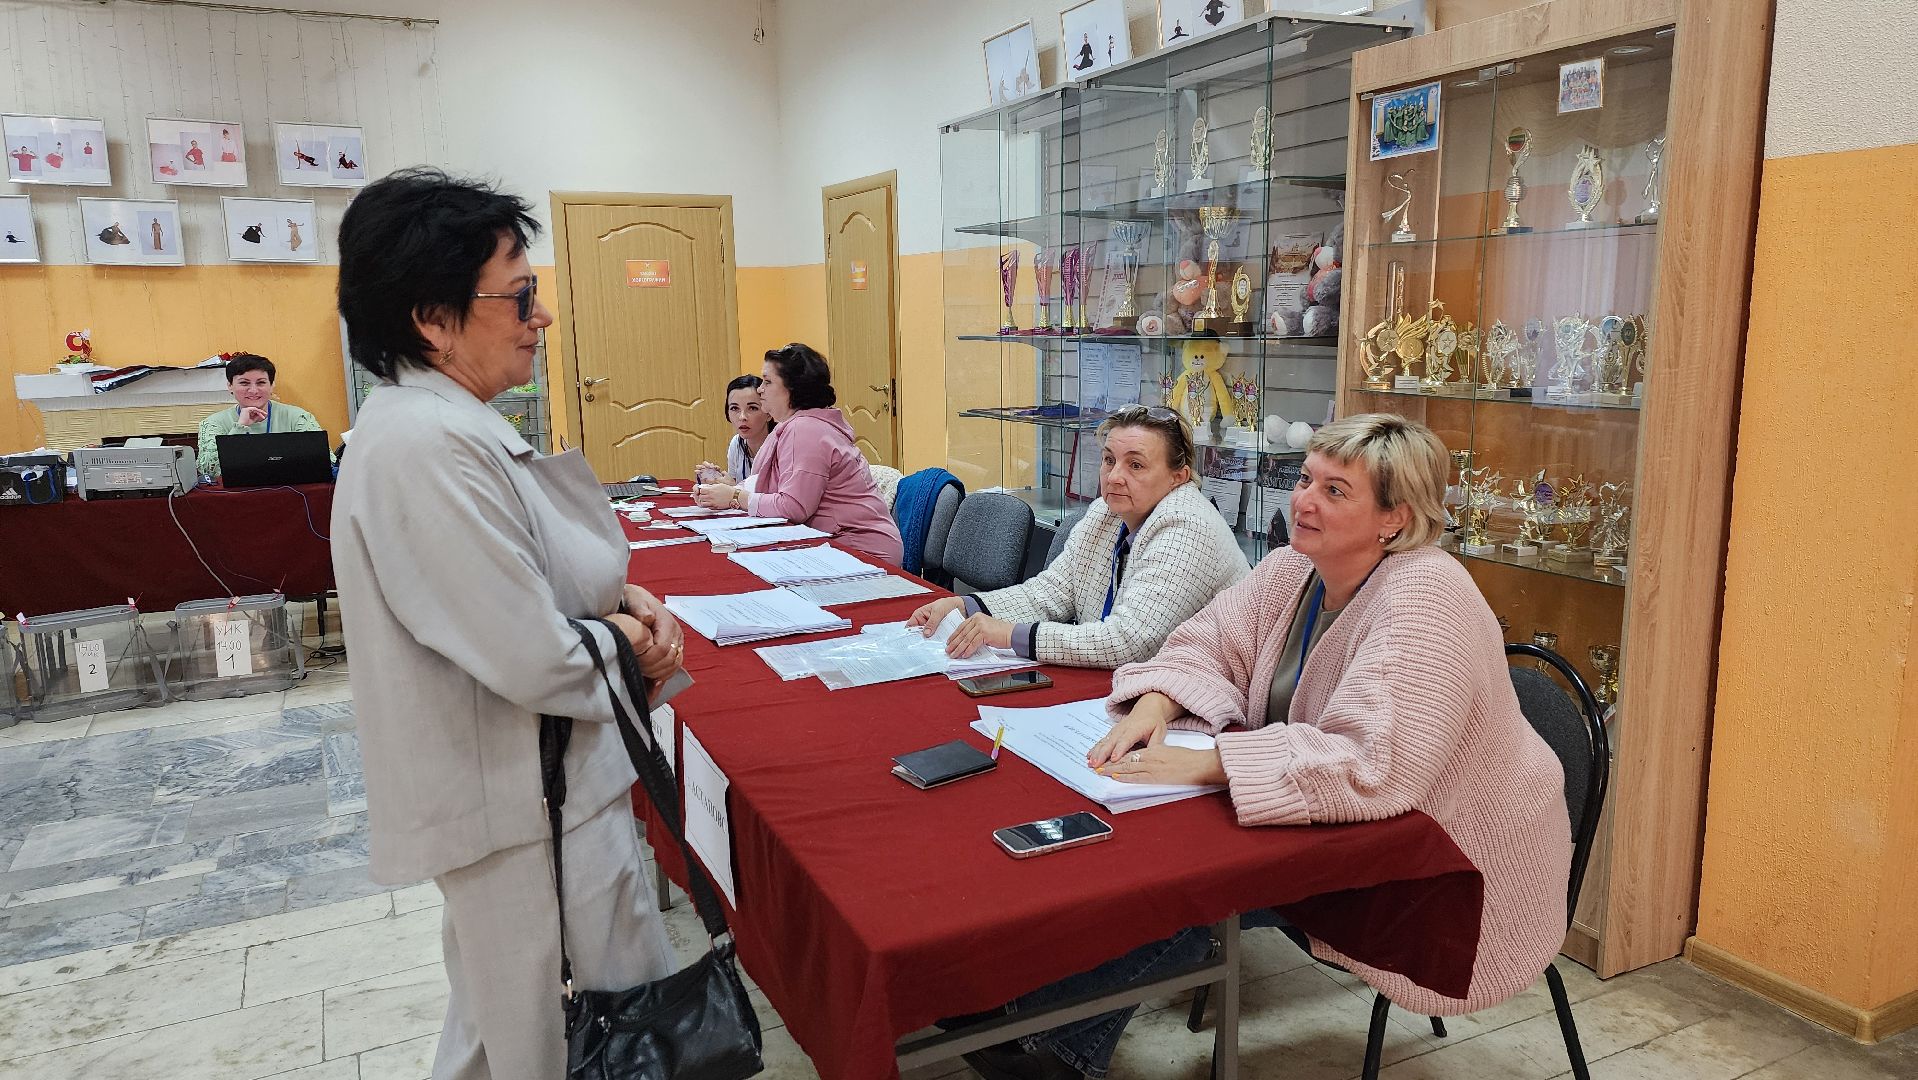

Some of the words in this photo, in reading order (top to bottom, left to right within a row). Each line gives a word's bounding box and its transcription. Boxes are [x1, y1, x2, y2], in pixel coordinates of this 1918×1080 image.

[215, 623, 242, 636] УИК
[224, 653, 235, 670] 1
[88, 663, 98, 675] 2
